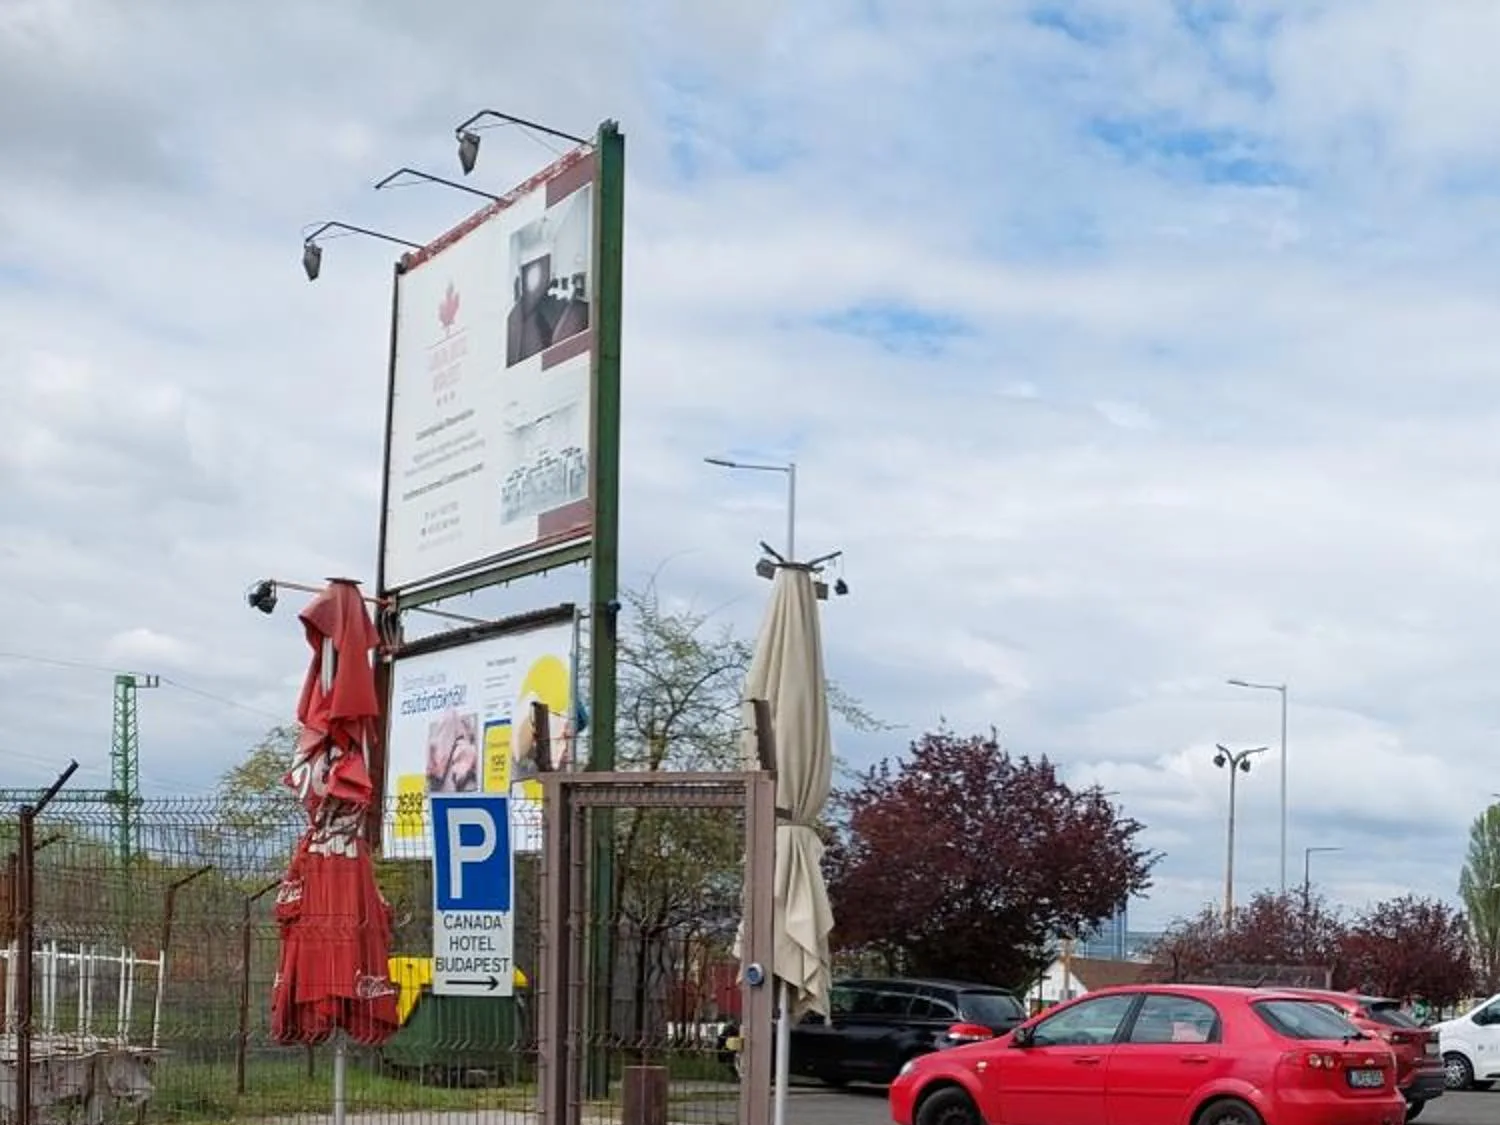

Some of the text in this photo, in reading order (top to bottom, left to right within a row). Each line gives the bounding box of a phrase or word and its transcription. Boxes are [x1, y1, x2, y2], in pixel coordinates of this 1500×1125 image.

[447, 807, 498, 899] P
[443, 914, 502, 931] CANADA
[449, 934, 496, 951] HOTEL
[435, 956, 511, 974] BUDAPEST
